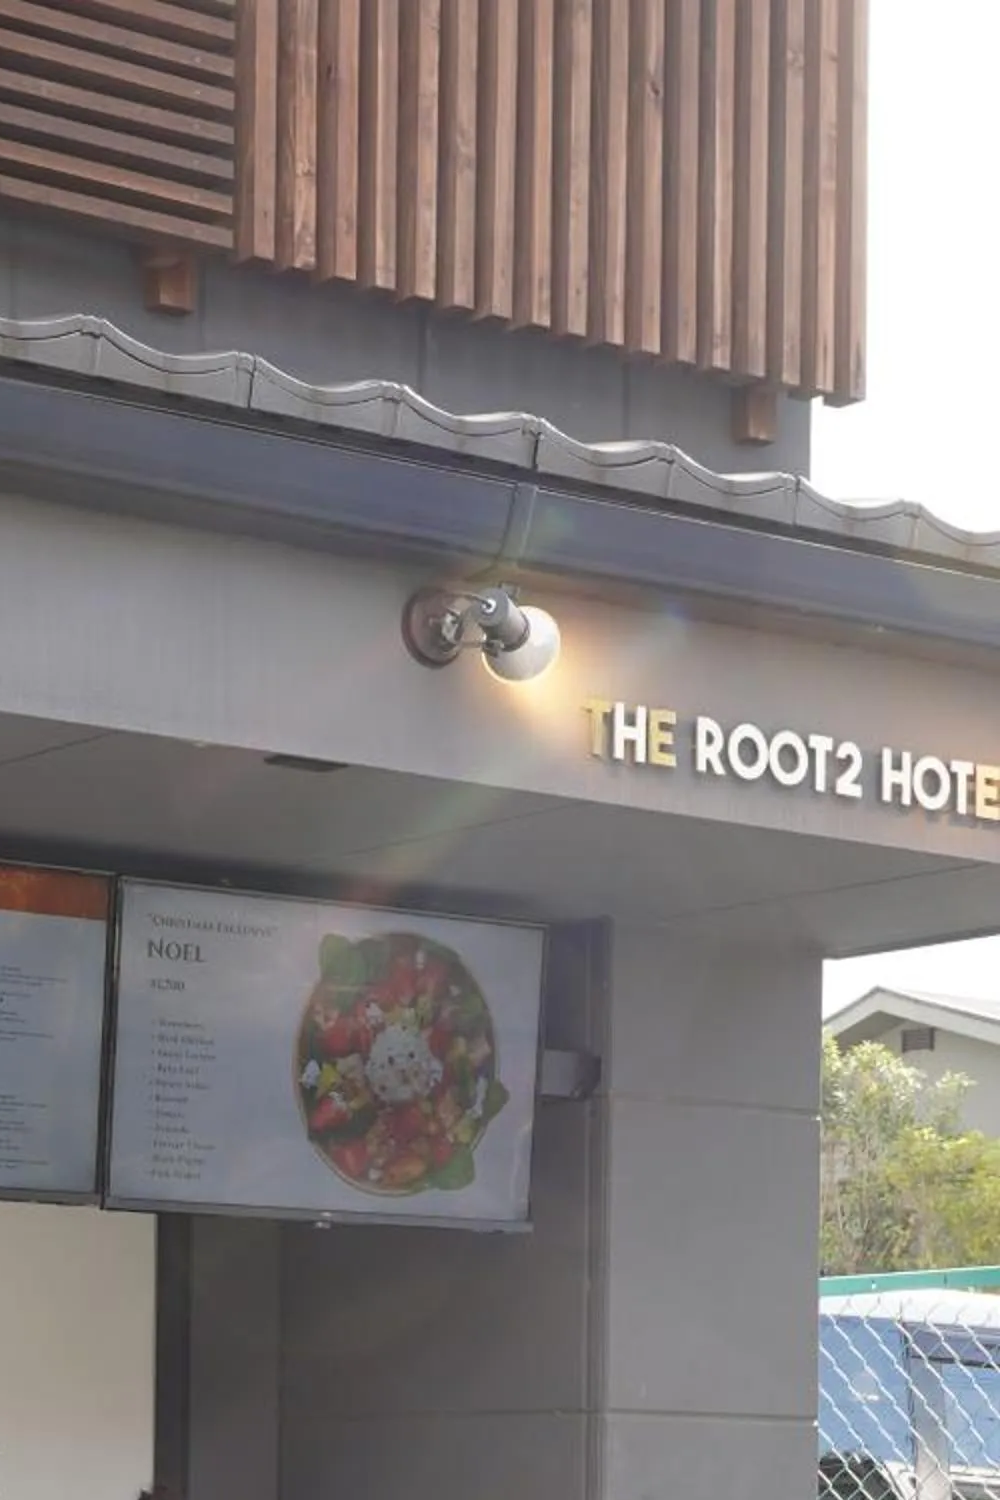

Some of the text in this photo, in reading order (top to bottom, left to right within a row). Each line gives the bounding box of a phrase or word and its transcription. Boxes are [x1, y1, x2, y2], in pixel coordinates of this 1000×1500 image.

[584, 699, 1000, 821] THE ROOT2 HOTE
[147, 936, 207, 963] NOEL
